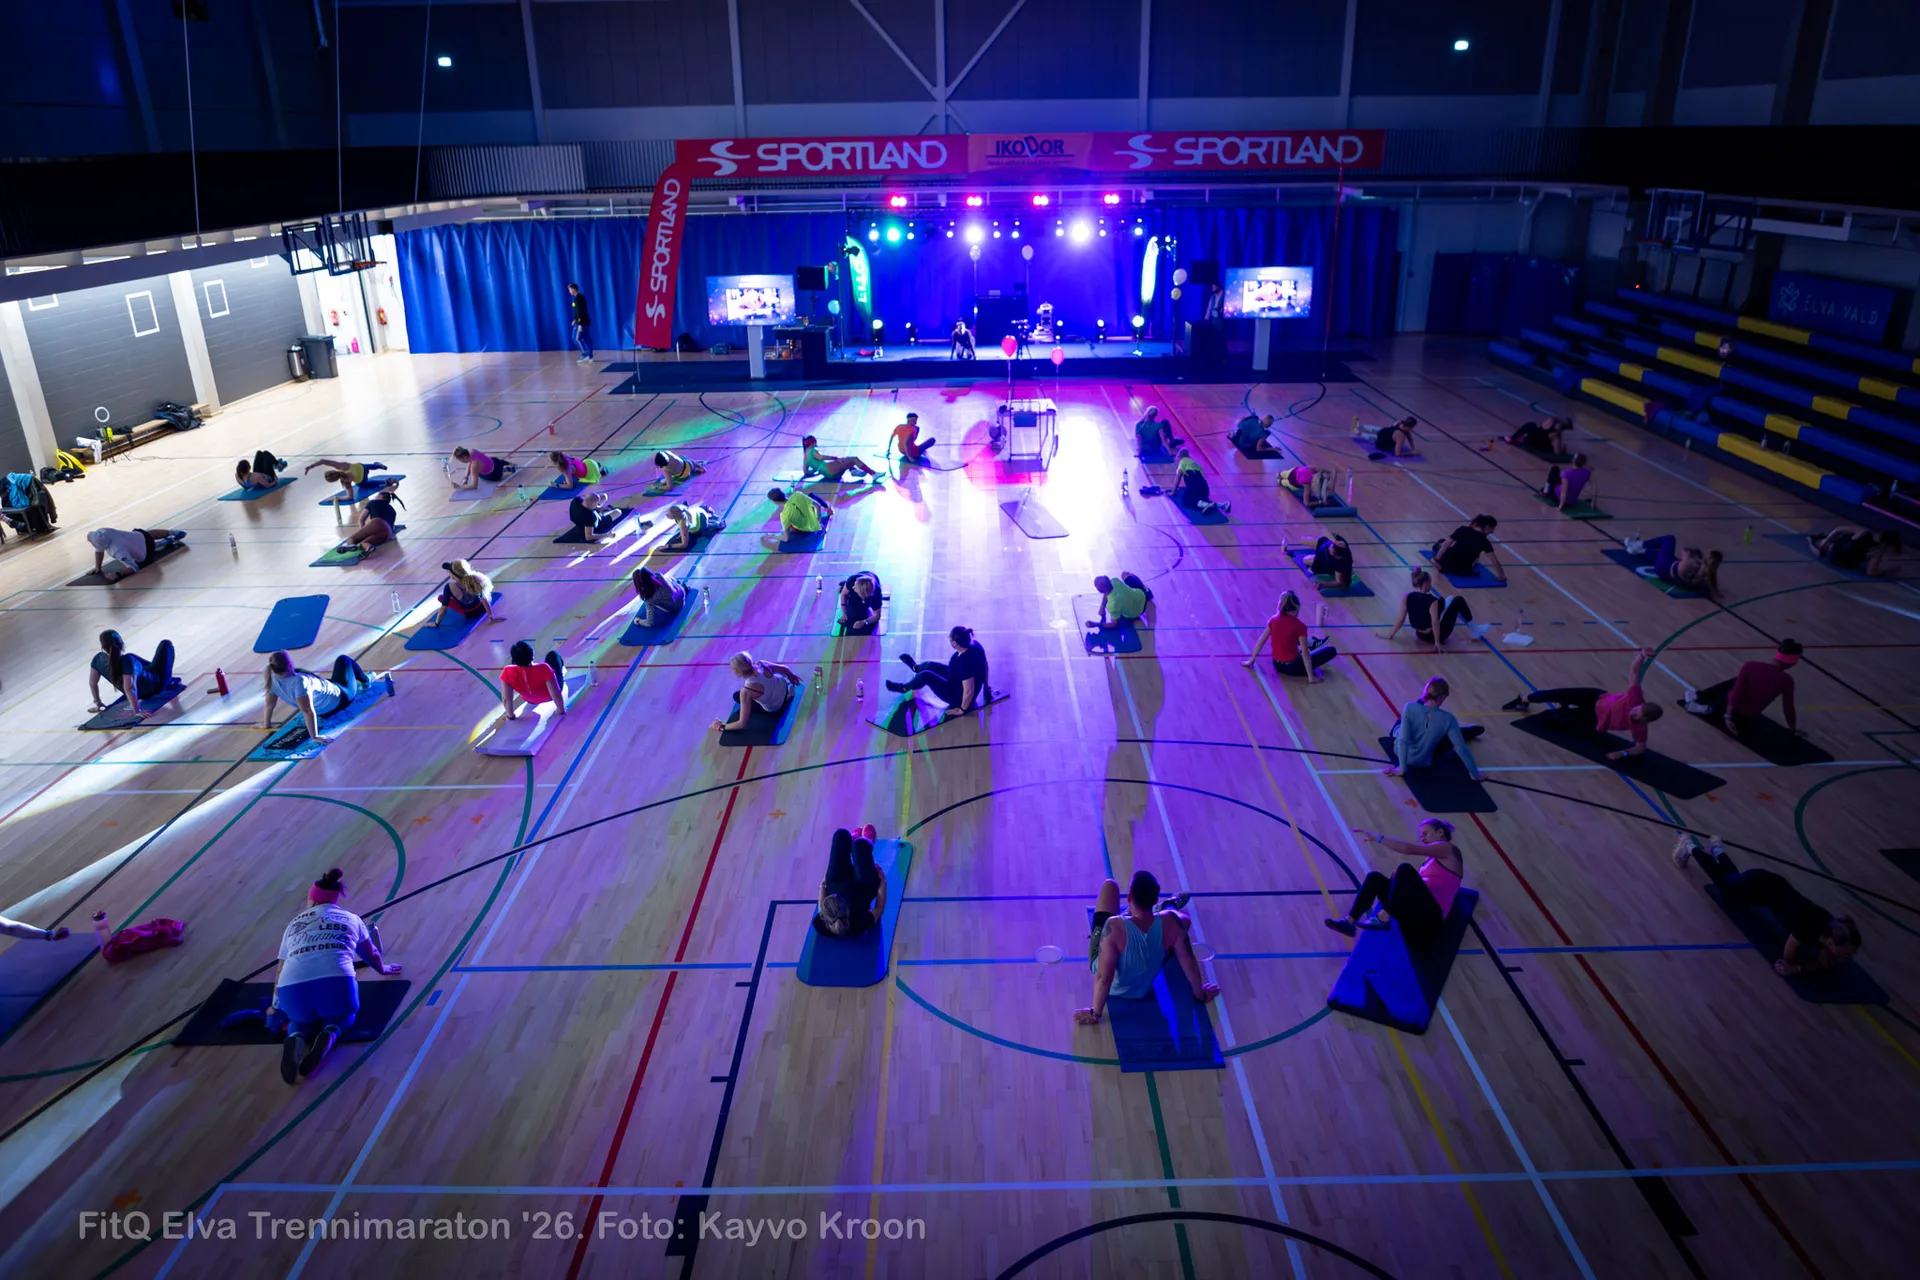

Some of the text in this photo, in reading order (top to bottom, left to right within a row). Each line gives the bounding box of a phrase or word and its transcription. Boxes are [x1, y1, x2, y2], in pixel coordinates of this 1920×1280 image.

[756, 140, 948, 172] SPORTLAND
[995, 135, 1065, 157] IKODOR
[1173, 135, 1363, 166] SPORTLAND
[650, 178, 681, 293] SPORTLAND
[1803, 295, 1878, 325] ELVA VALD
[319, 923, 348, 932] LESS
